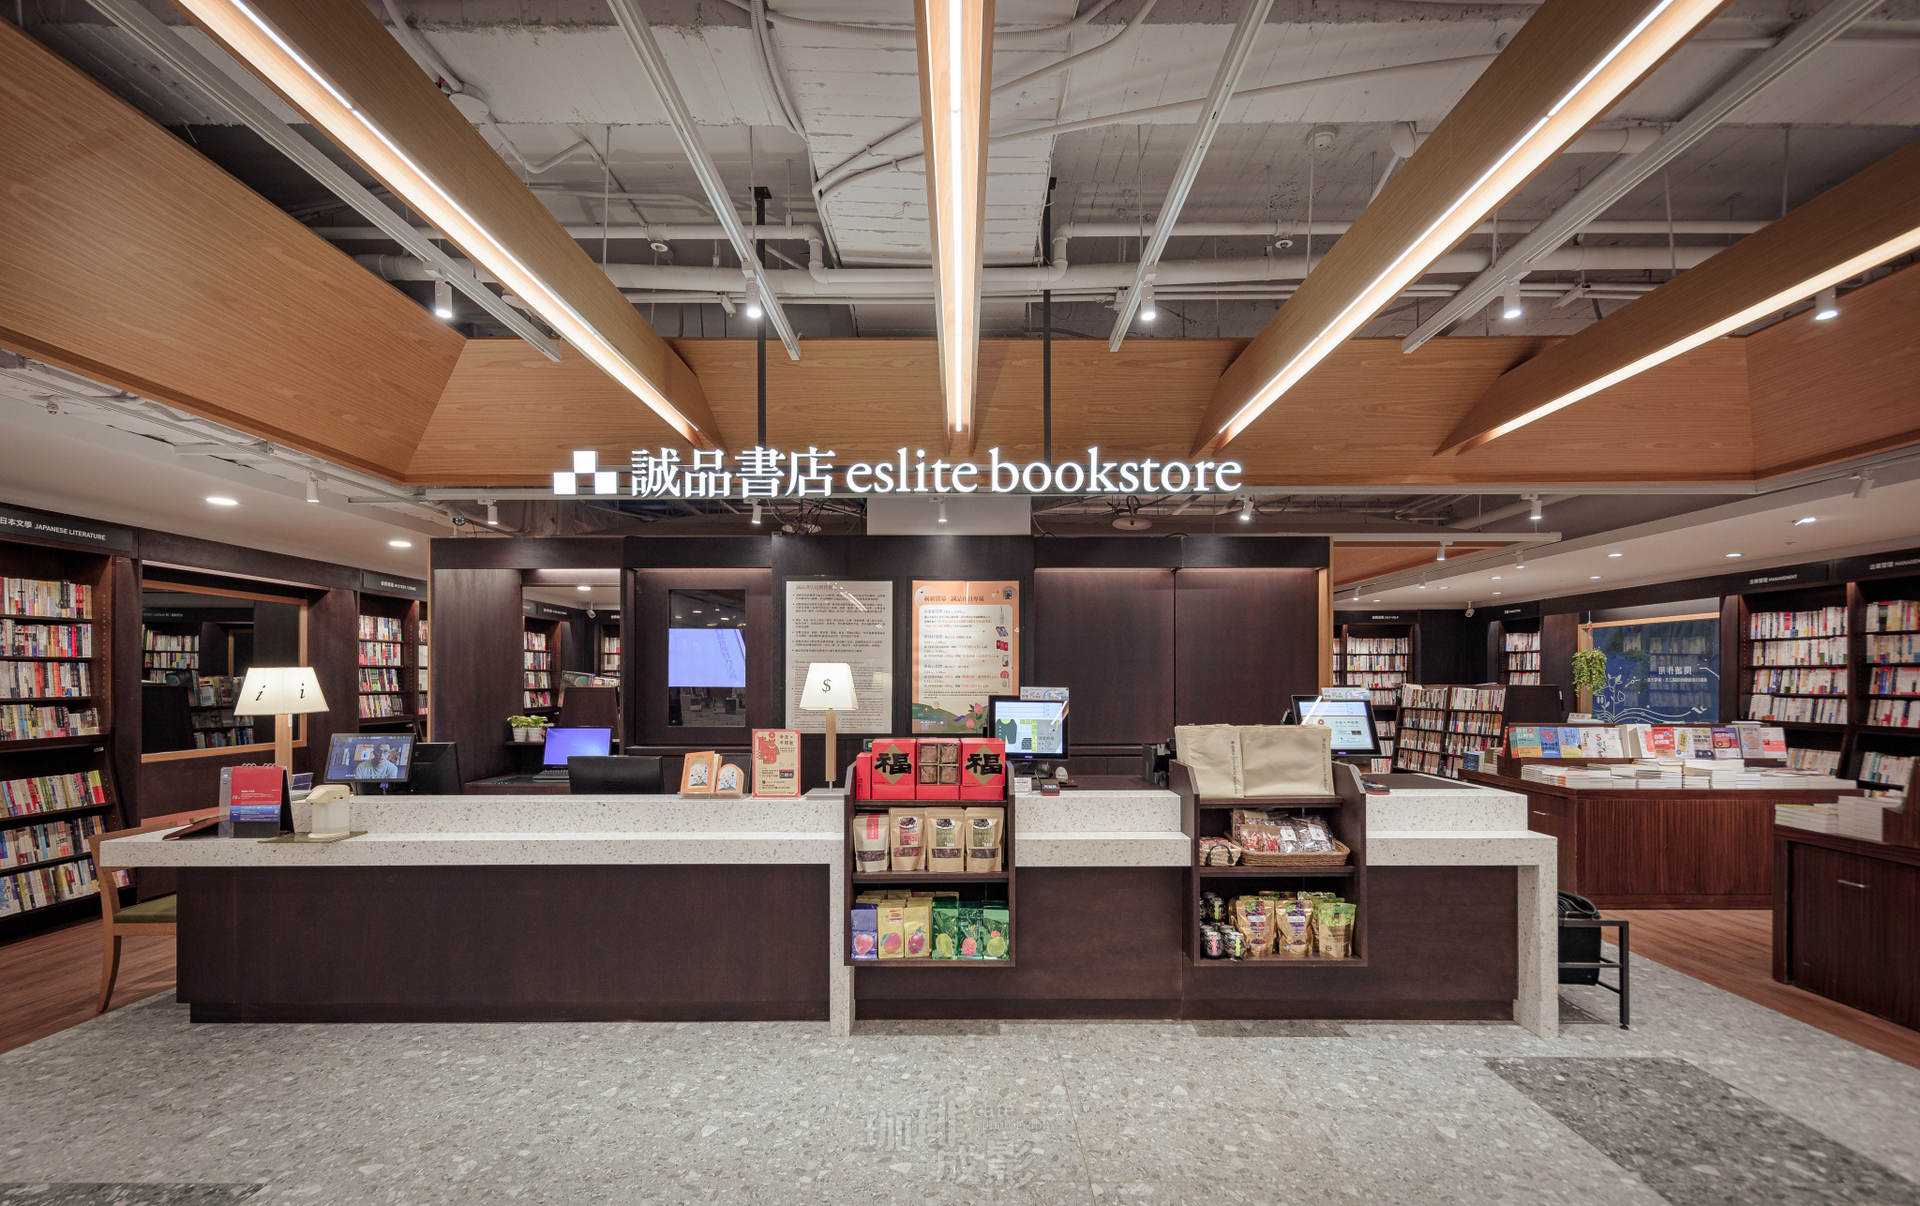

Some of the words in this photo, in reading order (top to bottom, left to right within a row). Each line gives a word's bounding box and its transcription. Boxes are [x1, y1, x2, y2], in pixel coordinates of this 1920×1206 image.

[631, 446, 836, 498] 誠品書店
[846, 447, 978, 493] eslite
[988, 446, 1242, 493] bookstore
[0, 516, 33, 529] 日本文學
[34, 523, 68, 535] JAPANESE
[69, 529, 106, 541] LITERATURE
[821, 678, 832, 694] $
[874, 752, 912, 775] 福
[965, 753, 1003, 775] 福
